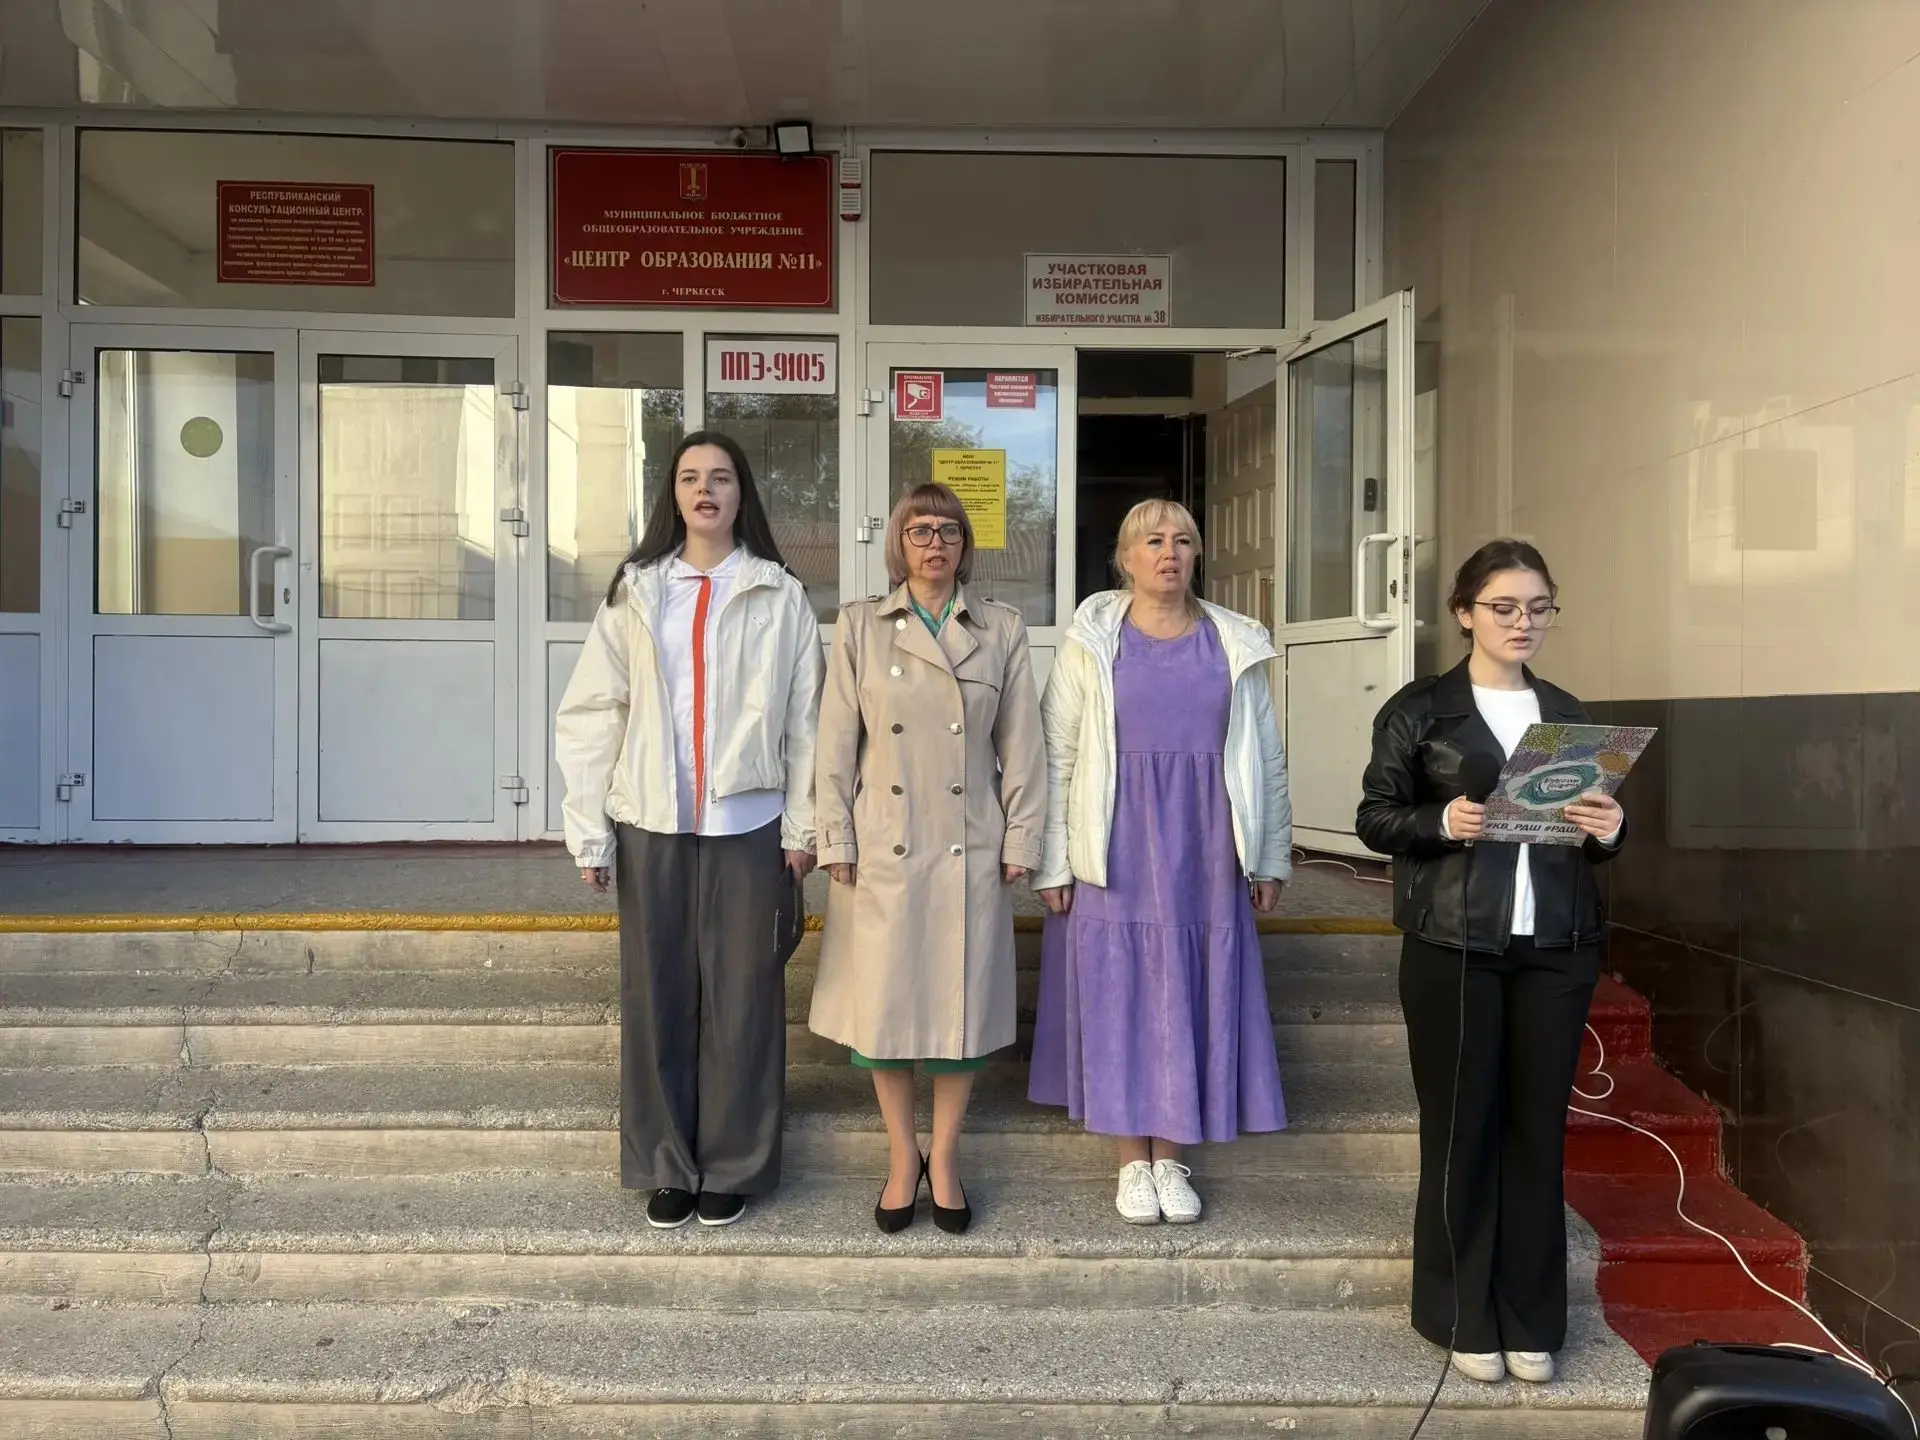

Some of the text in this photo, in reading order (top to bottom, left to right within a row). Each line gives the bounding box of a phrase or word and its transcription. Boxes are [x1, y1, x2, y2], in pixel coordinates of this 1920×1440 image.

[250, 190, 341, 202] РЕСПУБЛИКАНСКИЙ
[228, 204, 365, 217] КОНСУЛЬТАЦИОННЫЙ ЦЕНТР.
[603, 209, 783, 221] МУНИЦИПАЛЬНОЕ БЮДЖЕТНОЕ
[582, 224, 804, 236] ОБЩЕОБРАЗОВАТЕЛЬНОЕ УЧРЕЖДЕНИЕ
[564, 250, 823, 270] «ЦЕНТР ОБРАЗОВАНИЯ №11»
[1048, 263, 1147, 275] УЧАСТКОВАЯ
[1032, 277, 1163, 290] ИЗБИРАТЕЛЬНАЯ
[672, 287, 725, 296] ЧЕРКЕССК
[1055, 293, 1140, 305] КОМИССИЯ
[1035, 313, 1105, 323] ИЗБИРАТЕЛЬНОГО
[1107, 314, 1141, 323] УЧАСТКА
[1153, 310, 1166, 323] 38
